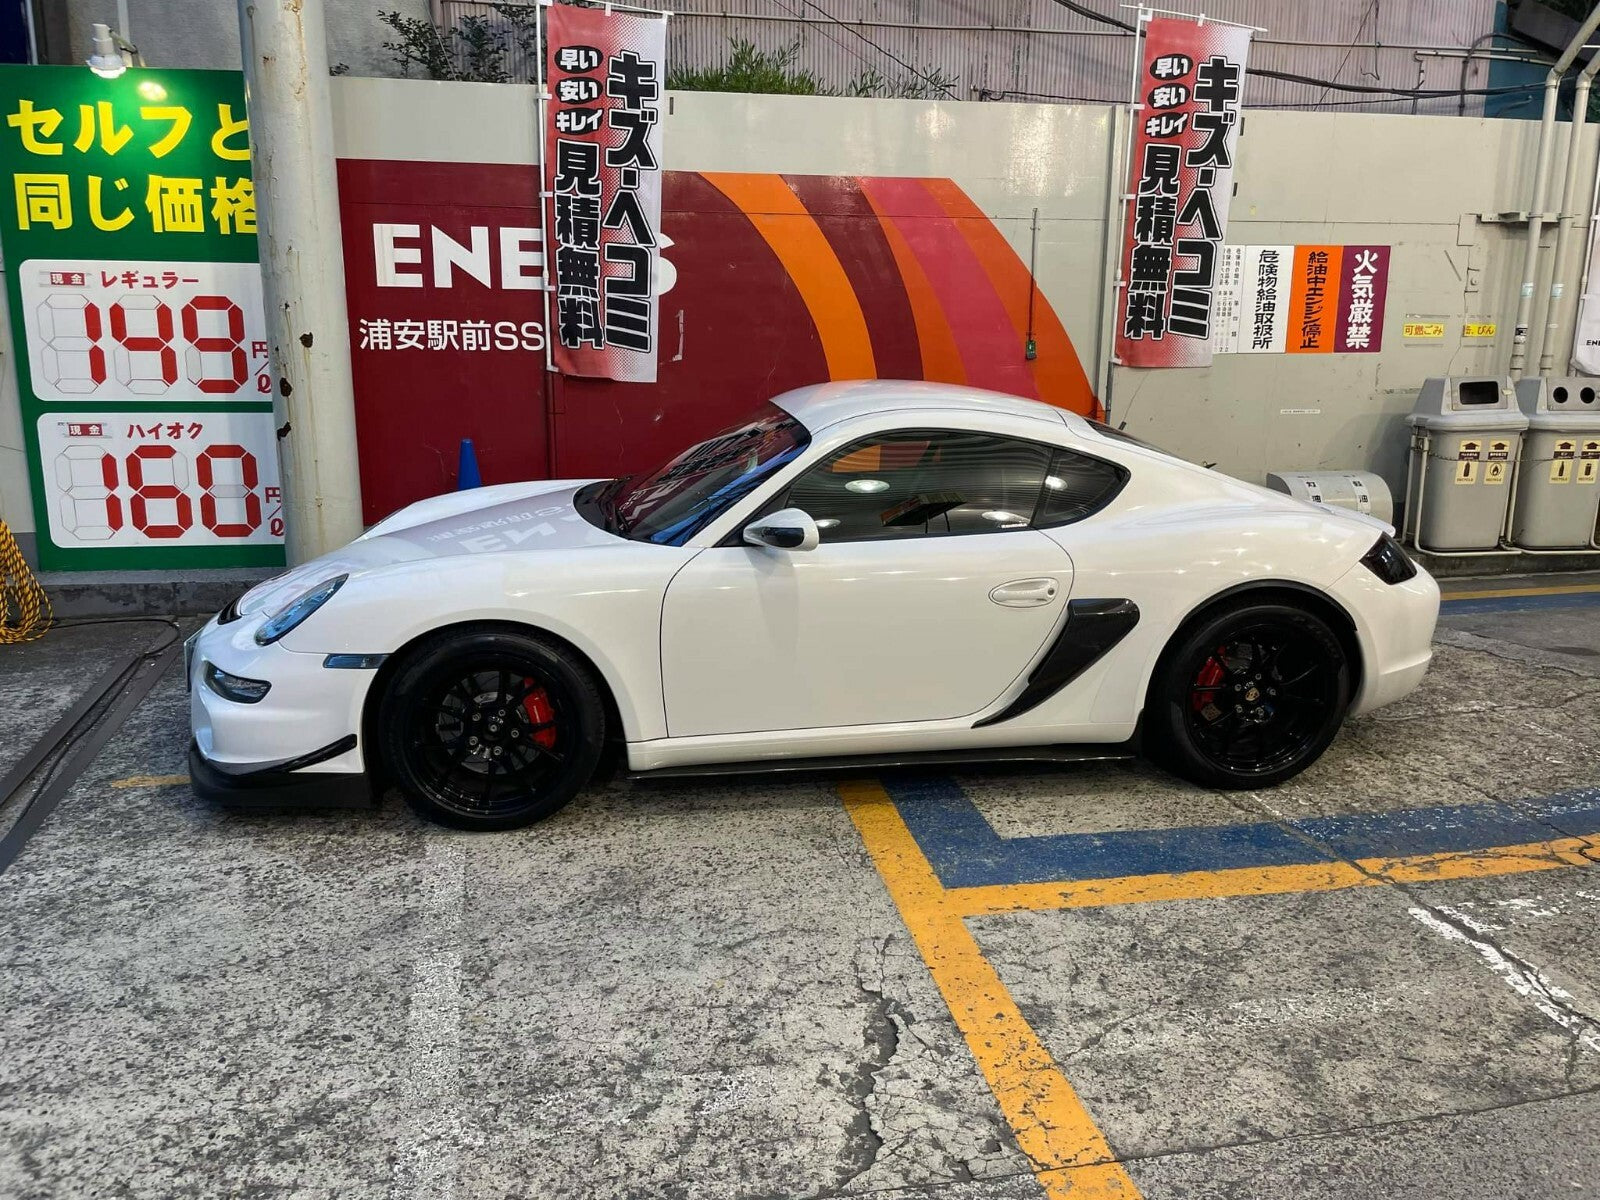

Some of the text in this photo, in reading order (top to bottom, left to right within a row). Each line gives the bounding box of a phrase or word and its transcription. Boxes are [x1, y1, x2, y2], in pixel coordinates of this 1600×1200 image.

[560, 49, 598, 70] 早い
[1155, 57, 1189, 78] 早い
[560, 80, 598, 102] 安い
[1153, 87, 1186, 108] 安い
[7, 99, 252, 161] セルフと
[556, 109, 604, 132] キレイ
[1146, 113, 1189, 137] キレイ
[13, 173, 258, 235] 同じ価格
[602, 50, 658, 352] キズ・ヘコミ
[1168, 55, 1240, 340] キズ・ヘコミ
[554, 139, 605, 350] 見積無料
[1124, 143, 1182, 340] 見積無料
[51, 273, 84, 285] 現金
[100, 270, 200, 290] レギュラー
[1252, 249, 1280, 350] 危険物給油取扱所
[1300, 251, 1329, 349] 給油中エンジン停止
[1346, 250, 1379, 350] 火気厳禁
[84, 295, 249, 394] 149
[359, 318, 545, 351] 浦安駅前SS
[69, 424, 102, 436] 現金
[127, 422, 204, 440] ハイオク
[101, 444, 263, 538] 160
